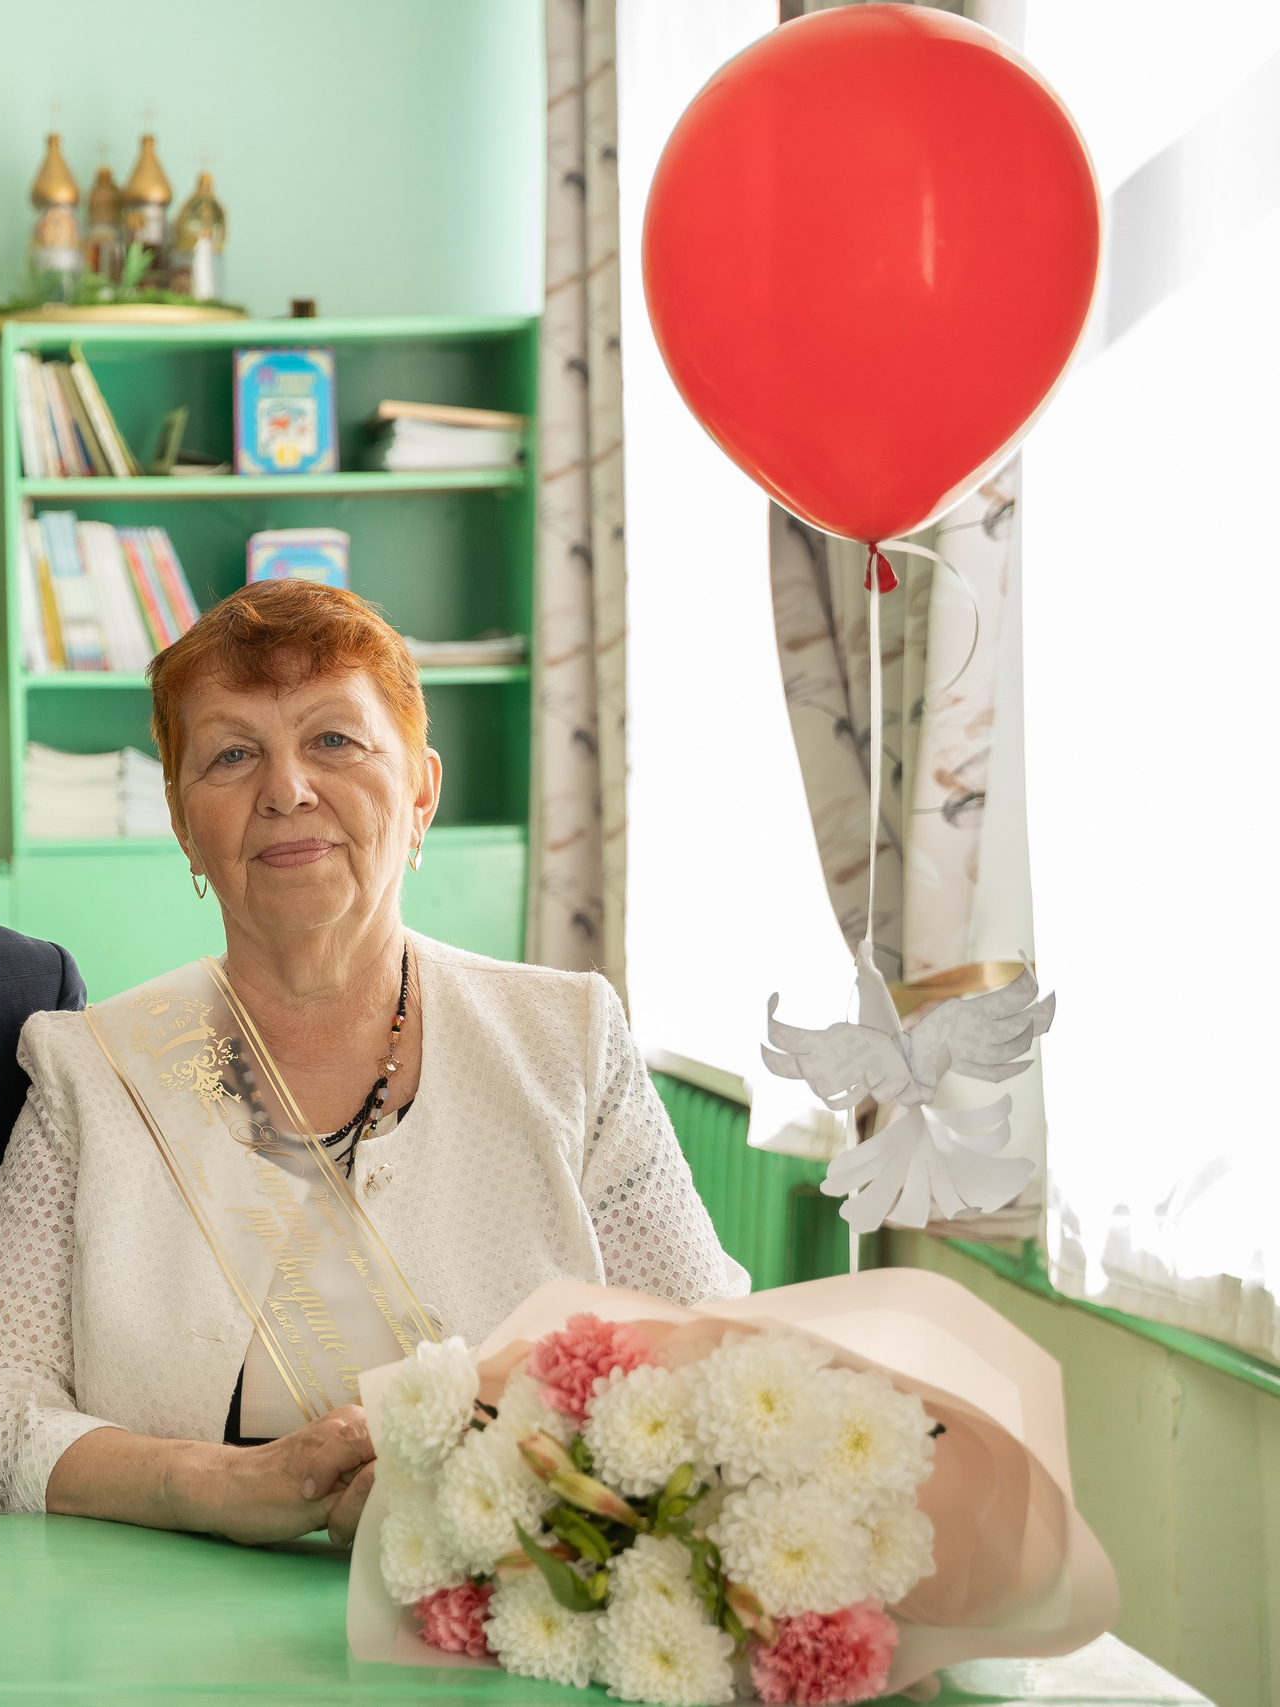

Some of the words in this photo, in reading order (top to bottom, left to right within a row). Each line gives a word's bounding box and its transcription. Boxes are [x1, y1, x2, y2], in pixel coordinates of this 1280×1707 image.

[154, 1028, 166, 1040] 11
[170, 1015, 192, 1030] «Б»
[229, 1119, 336, 1253] Классный
[266, 1296, 304, 1345] МБОУ
[344, 1239, 368, 1278] Софья
[366, 1280, 416, 1355] Николаевна
